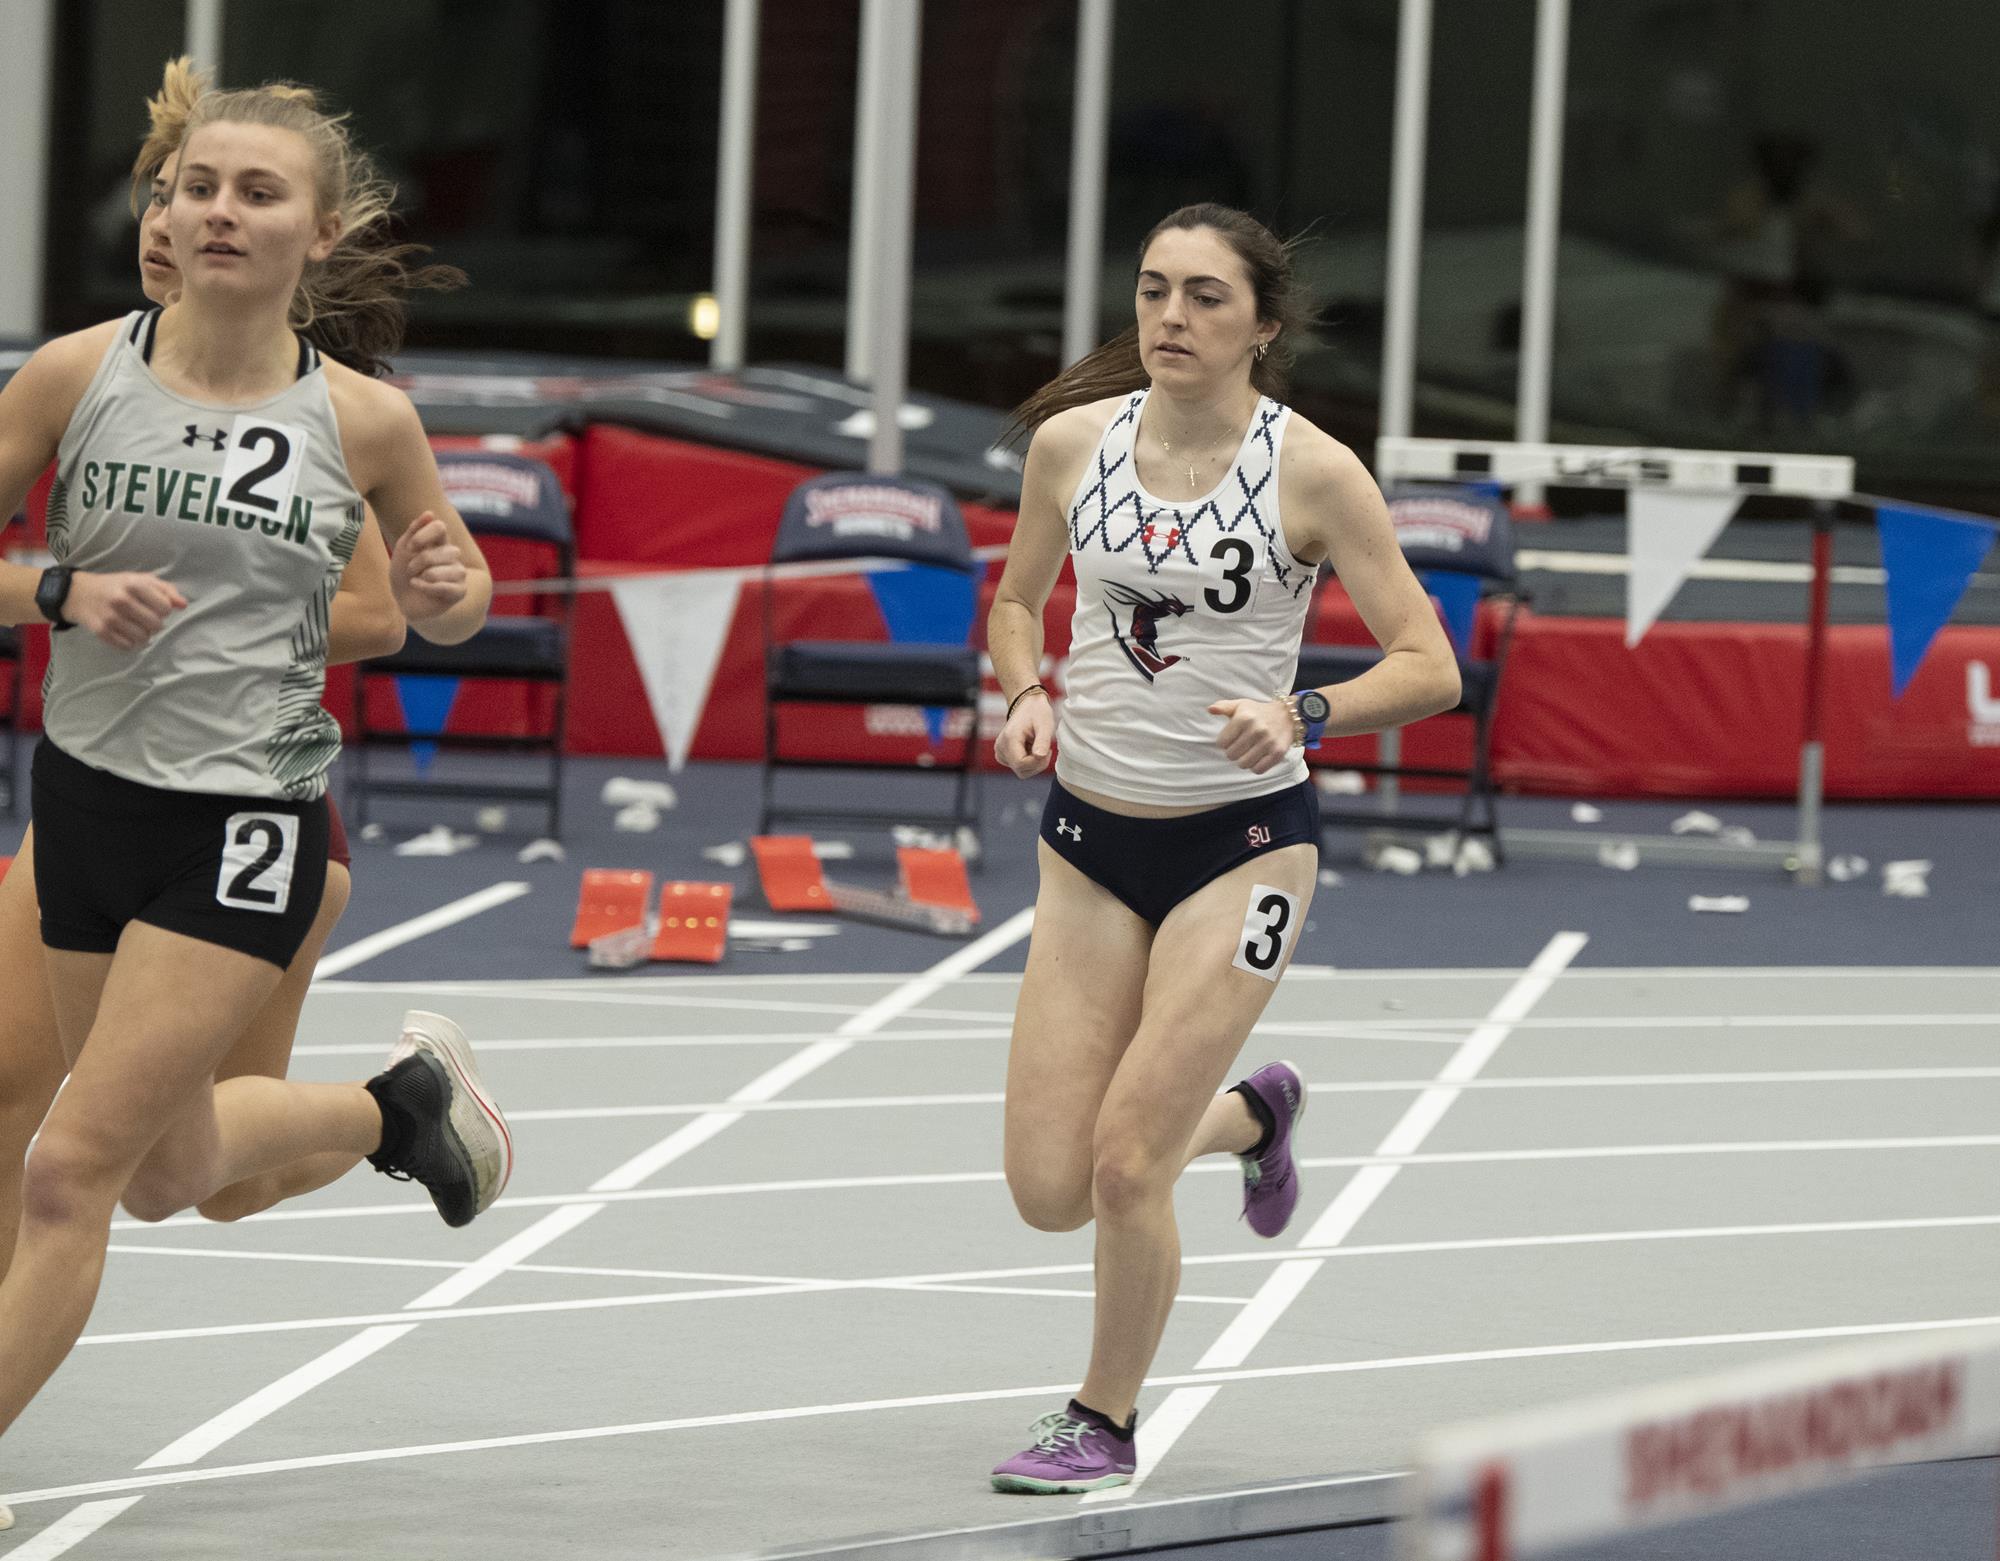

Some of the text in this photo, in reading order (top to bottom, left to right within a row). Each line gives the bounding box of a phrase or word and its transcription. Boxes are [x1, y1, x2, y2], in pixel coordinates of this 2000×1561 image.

[226, 427, 291, 513] 2
[1203, 538, 1255, 614] 3
[225, 819, 285, 904] 2
[1248, 825, 1271, 845] SU
[1244, 894, 1291, 971] 3
